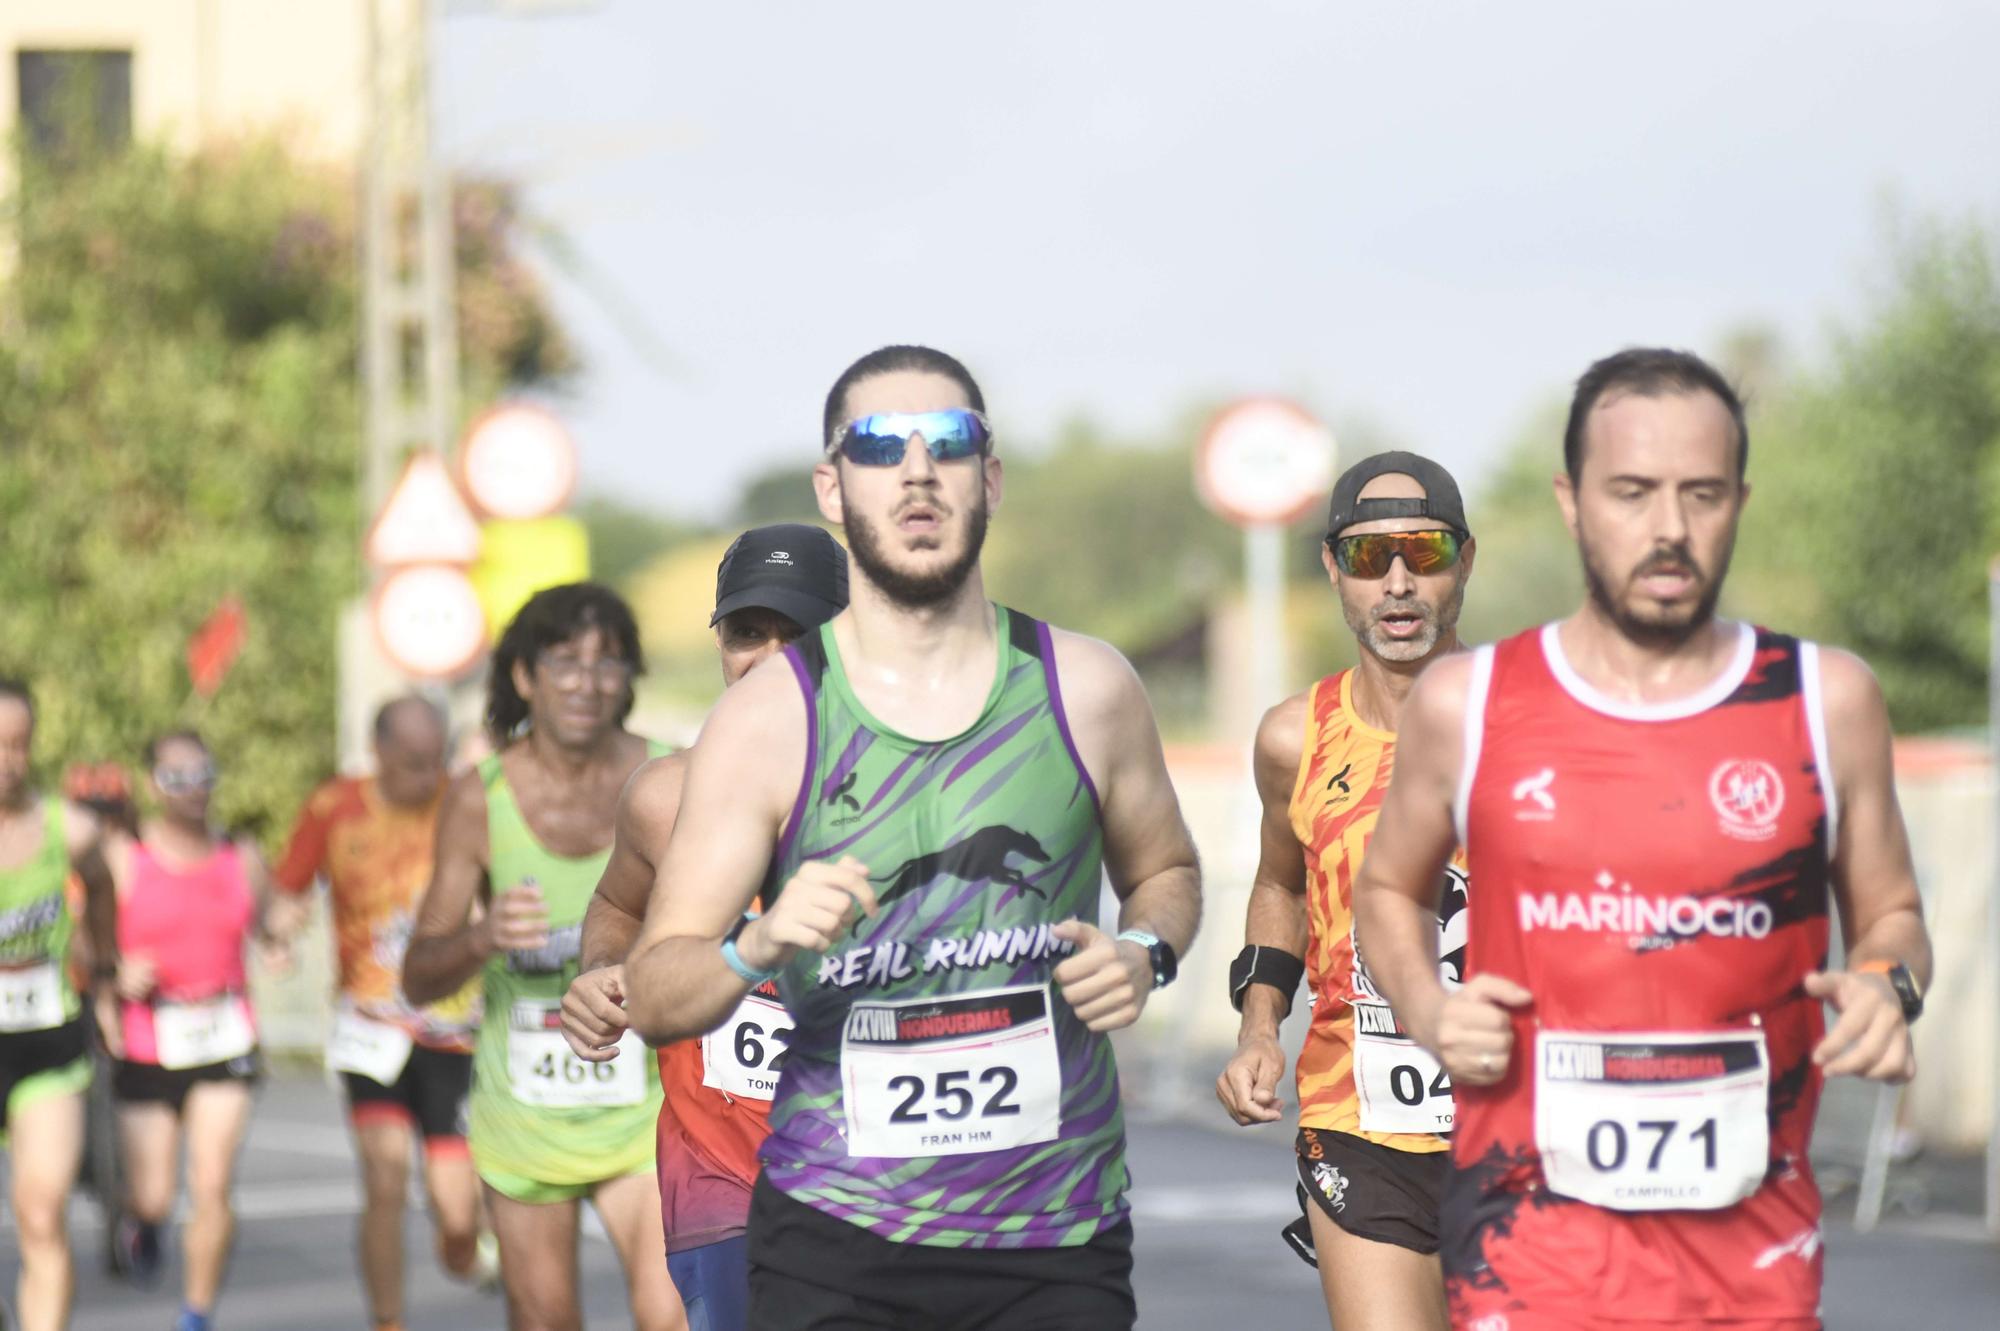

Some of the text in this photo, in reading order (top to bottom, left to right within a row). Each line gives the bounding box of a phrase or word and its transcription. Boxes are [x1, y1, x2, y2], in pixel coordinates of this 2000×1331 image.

[1518, 881, 1773, 939] MARINOCIO
[817, 941, 914, 988] REAL
[848, 1008, 898, 1041] XXVIII
[1359, 1004, 1396, 1035] XXVIII
[1547, 1042, 1603, 1080] XXVIII
[886, 1065, 1021, 1125] 252
[1435, 1114, 1457, 1124] TO
[921, 1131, 993, 1147] FRAN HM
[1586, 1118, 1718, 1173] 071
[1614, 1187, 1702, 1199] CAMPILLO
